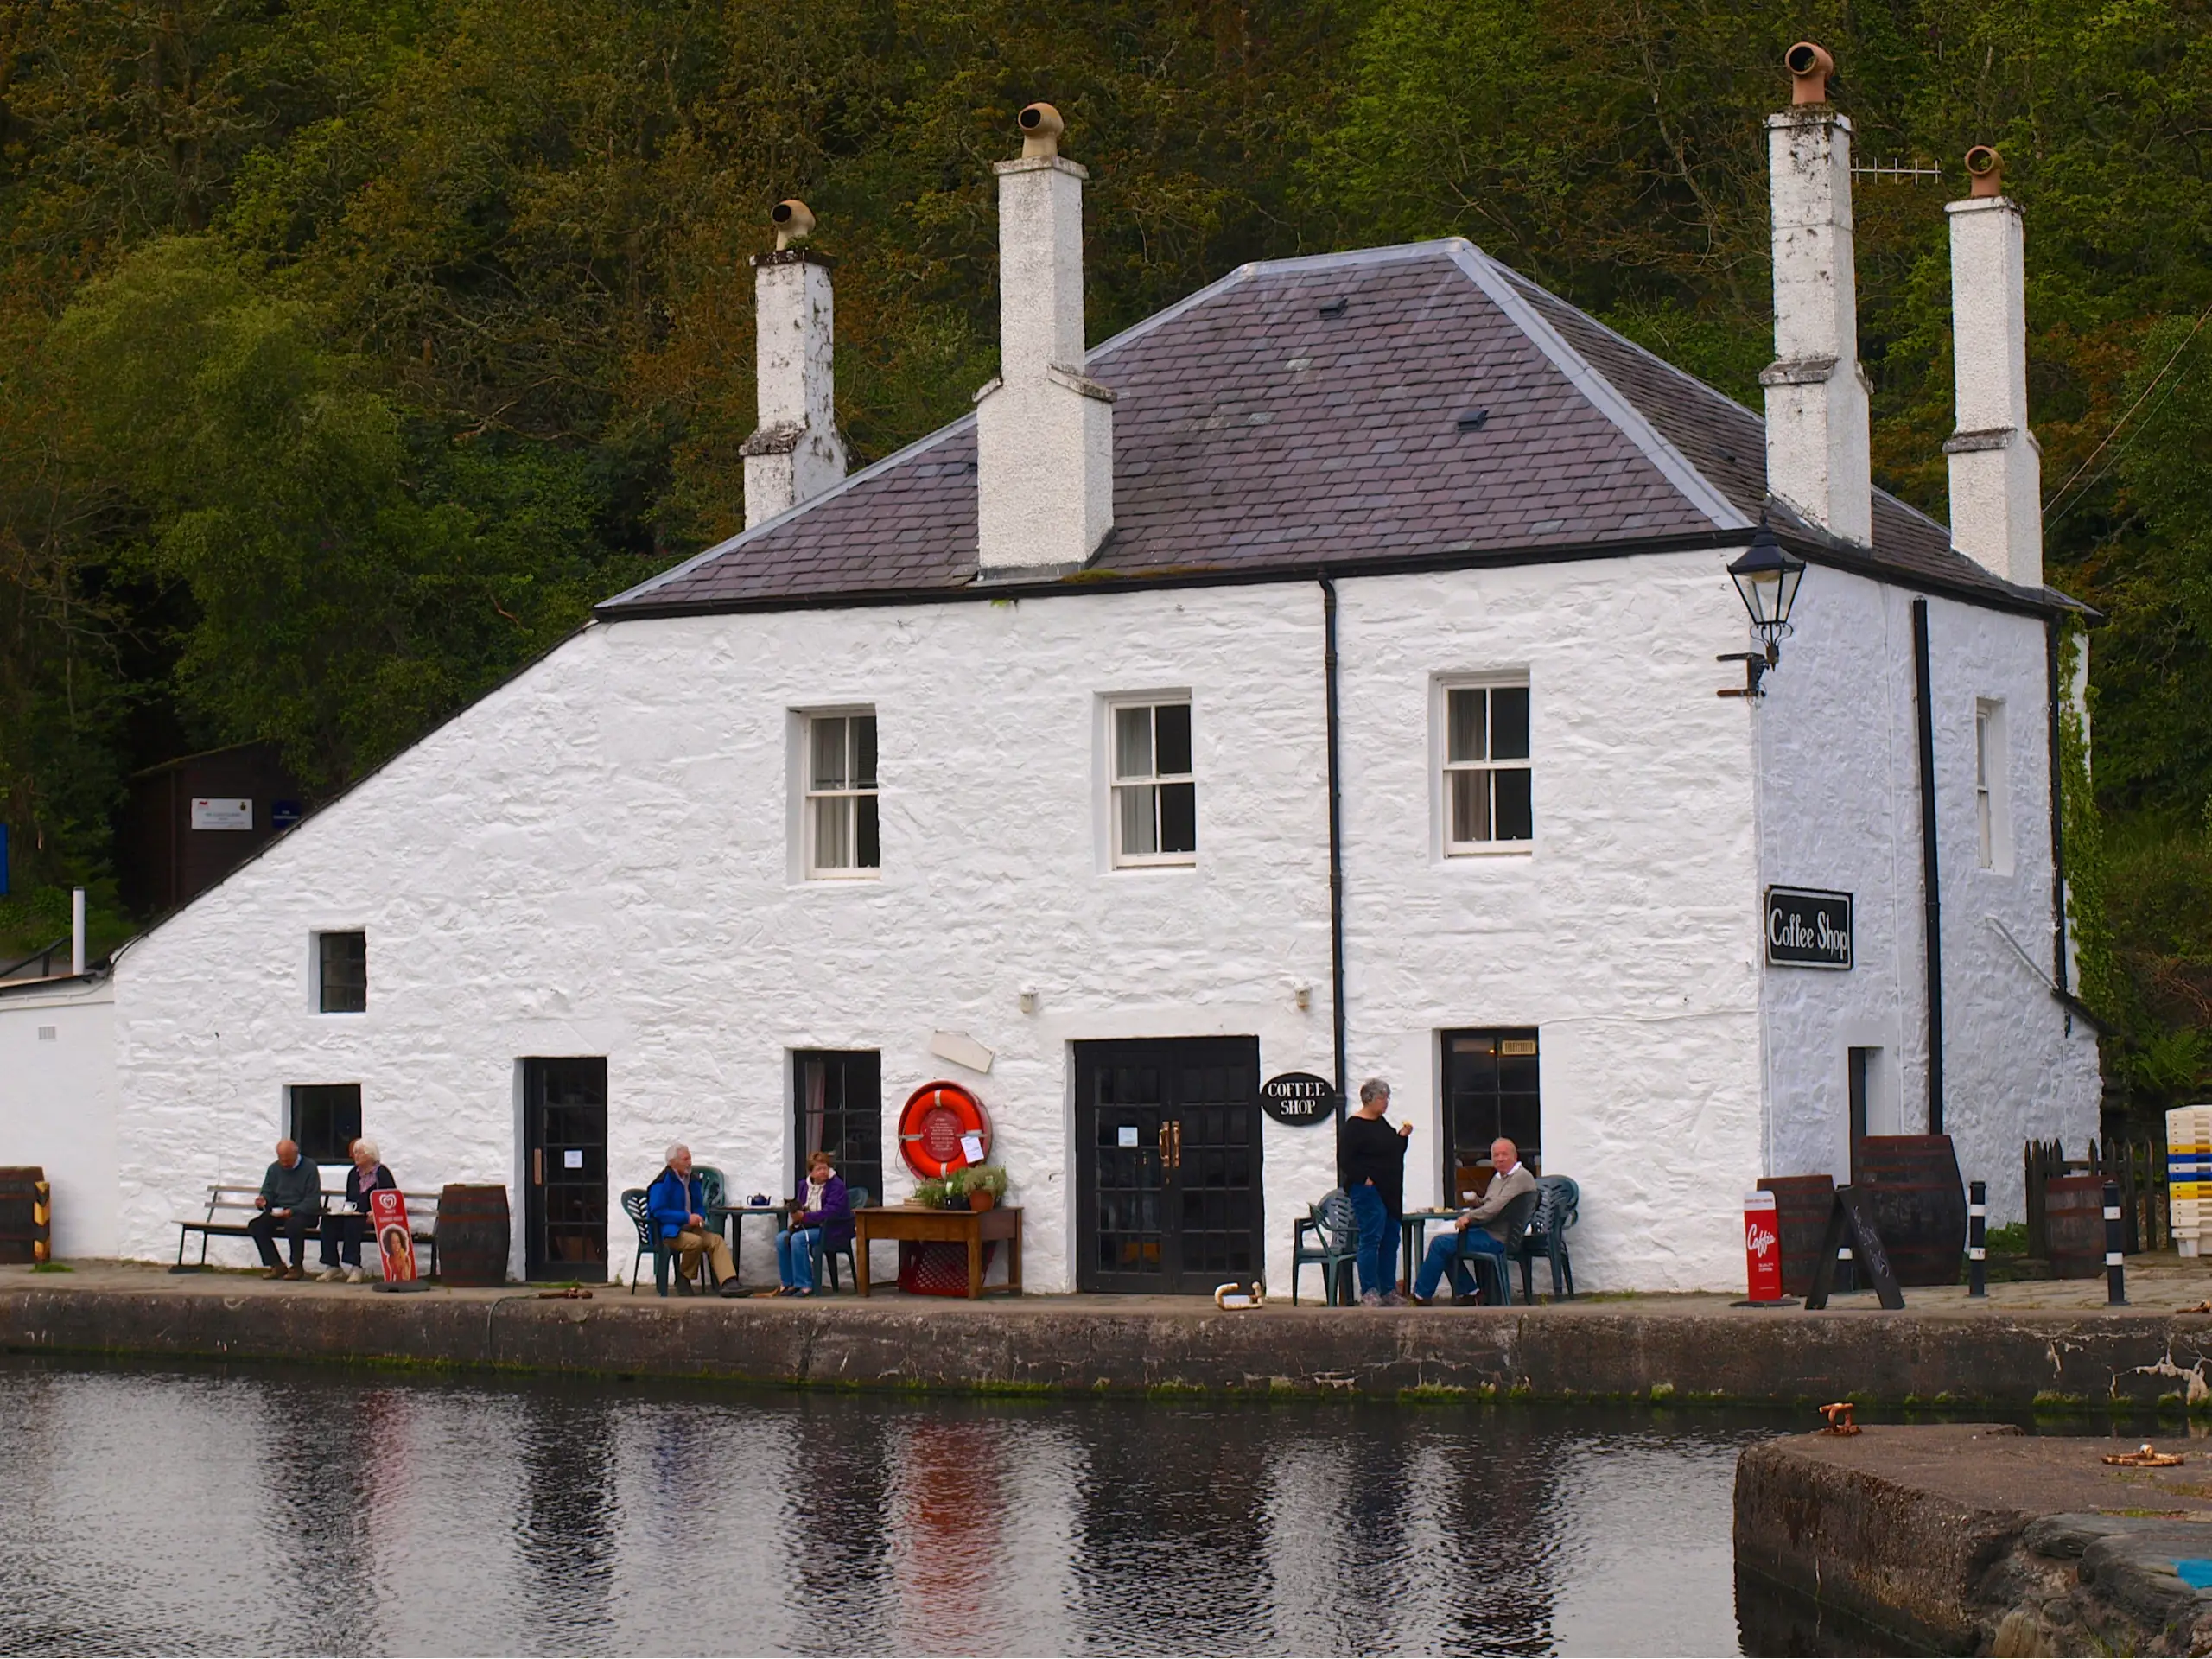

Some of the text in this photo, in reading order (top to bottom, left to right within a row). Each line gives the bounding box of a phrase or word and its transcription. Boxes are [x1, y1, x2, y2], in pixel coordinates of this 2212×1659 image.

[1770, 907, 1847, 960] Coffee Shop
[1268, 1082, 1325, 1097] COFFEE
[1281, 1100, 1316, 1115] SHOP
